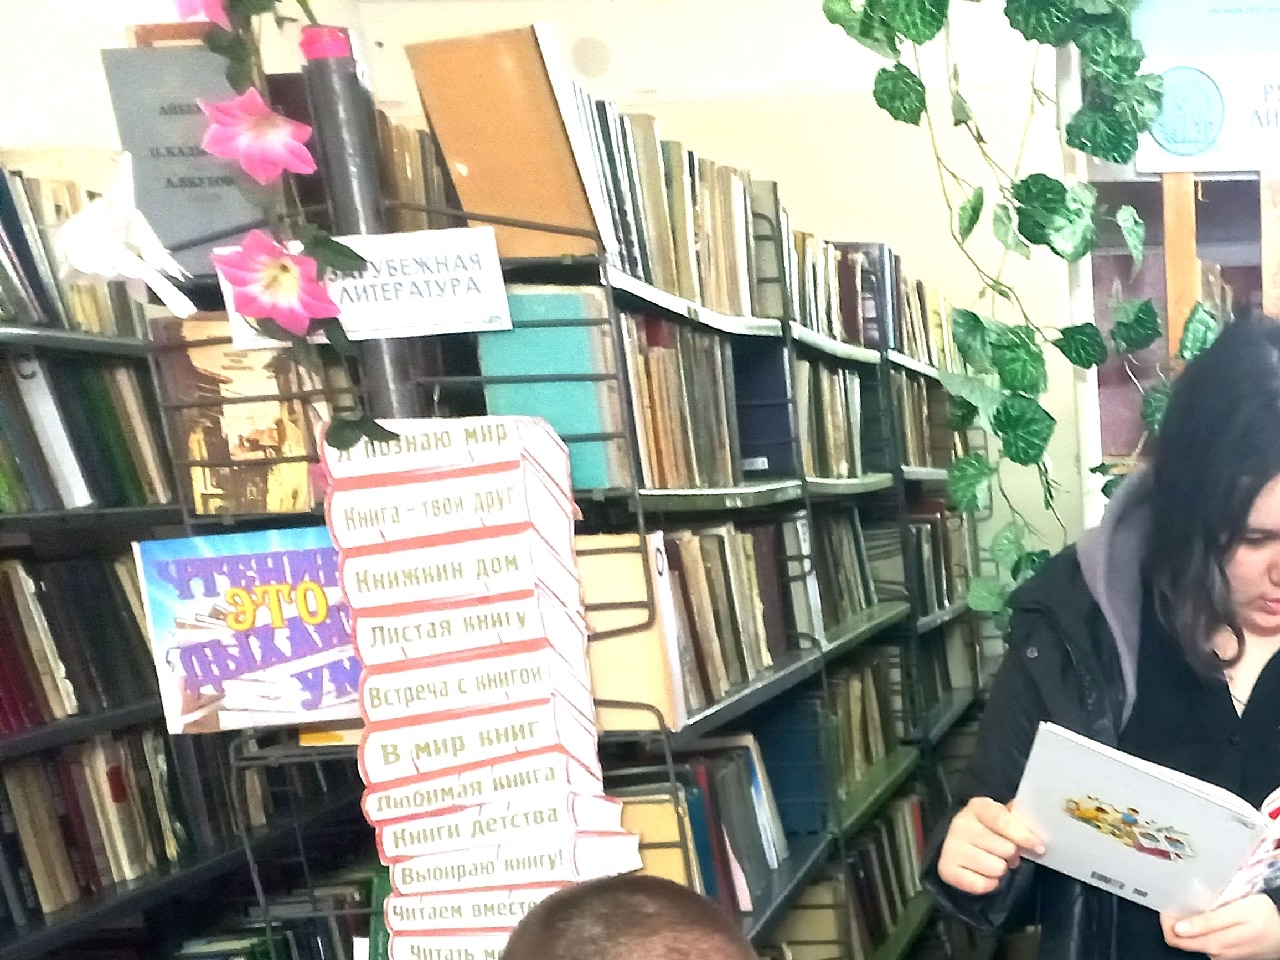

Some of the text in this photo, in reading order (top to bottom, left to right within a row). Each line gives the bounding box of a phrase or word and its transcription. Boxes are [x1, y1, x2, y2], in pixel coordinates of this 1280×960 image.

[340, 276, 482, 304] ЛИТЕРАТУРА
[464, 423, 508, 447] мир
[344, 506, 400, 531] Книга
[474, 486, 514, 514] друг
[355, 555, 520, 593] Книжкин дом
[226, 580, 329, 631] ЭТО
[370, 611, 526, 648] Листая книгу
[368, 681, 449, 709] Встреча
[457, 678, 468, 694] с
[381, 721, 540, 766] В мир книг
[377, 766, 556, 812] Любимая книга
[393, 807, 559, 849] Книги детства
[401, 849, 563, 886] Выбираю книгу!
[393, 904, 463, 922] Читаем
